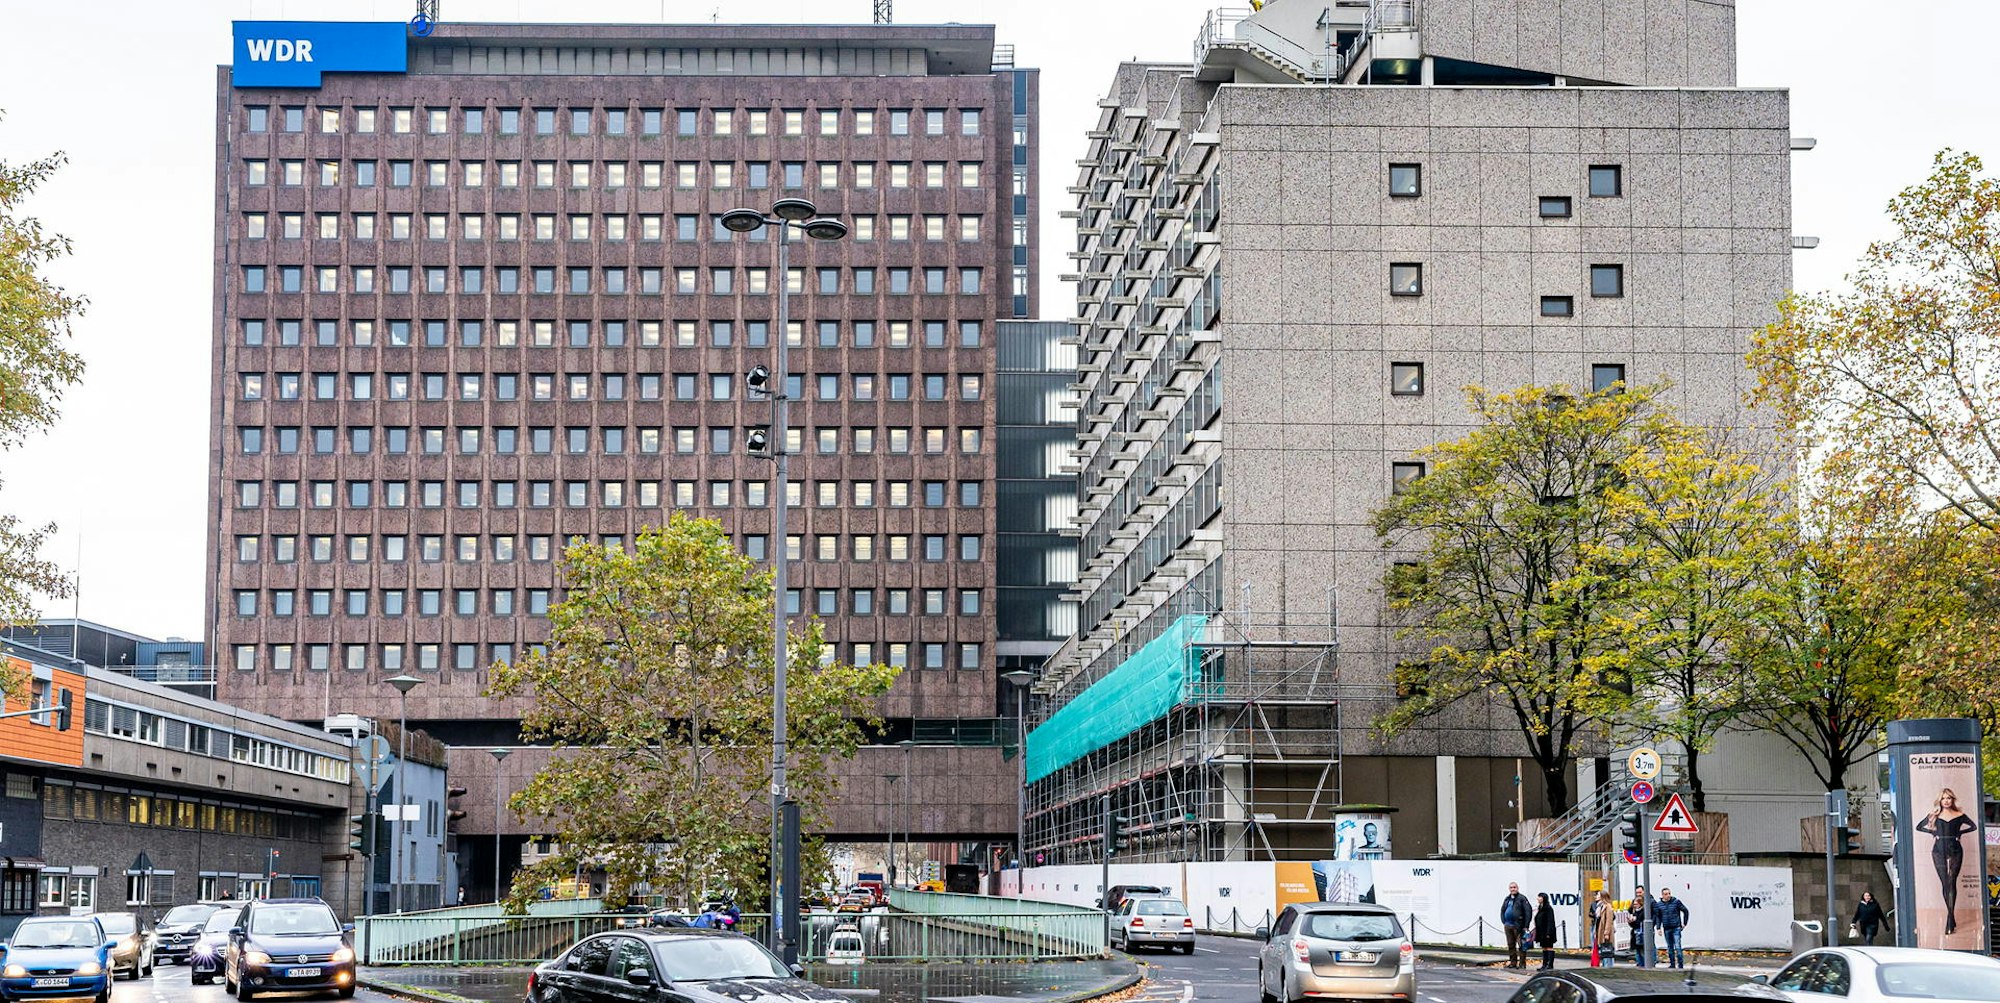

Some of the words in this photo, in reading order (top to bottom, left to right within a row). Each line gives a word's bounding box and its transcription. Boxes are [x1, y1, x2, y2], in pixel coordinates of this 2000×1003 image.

[247, 39, 313, 62] WDR
[1911, 757, 1974, 765] CALZEDONIA
[1413, 868, 1431, 876] WDR
[1219, 888, 1230, 897] WDR
[1730, 896, 1761, 909] WDR
